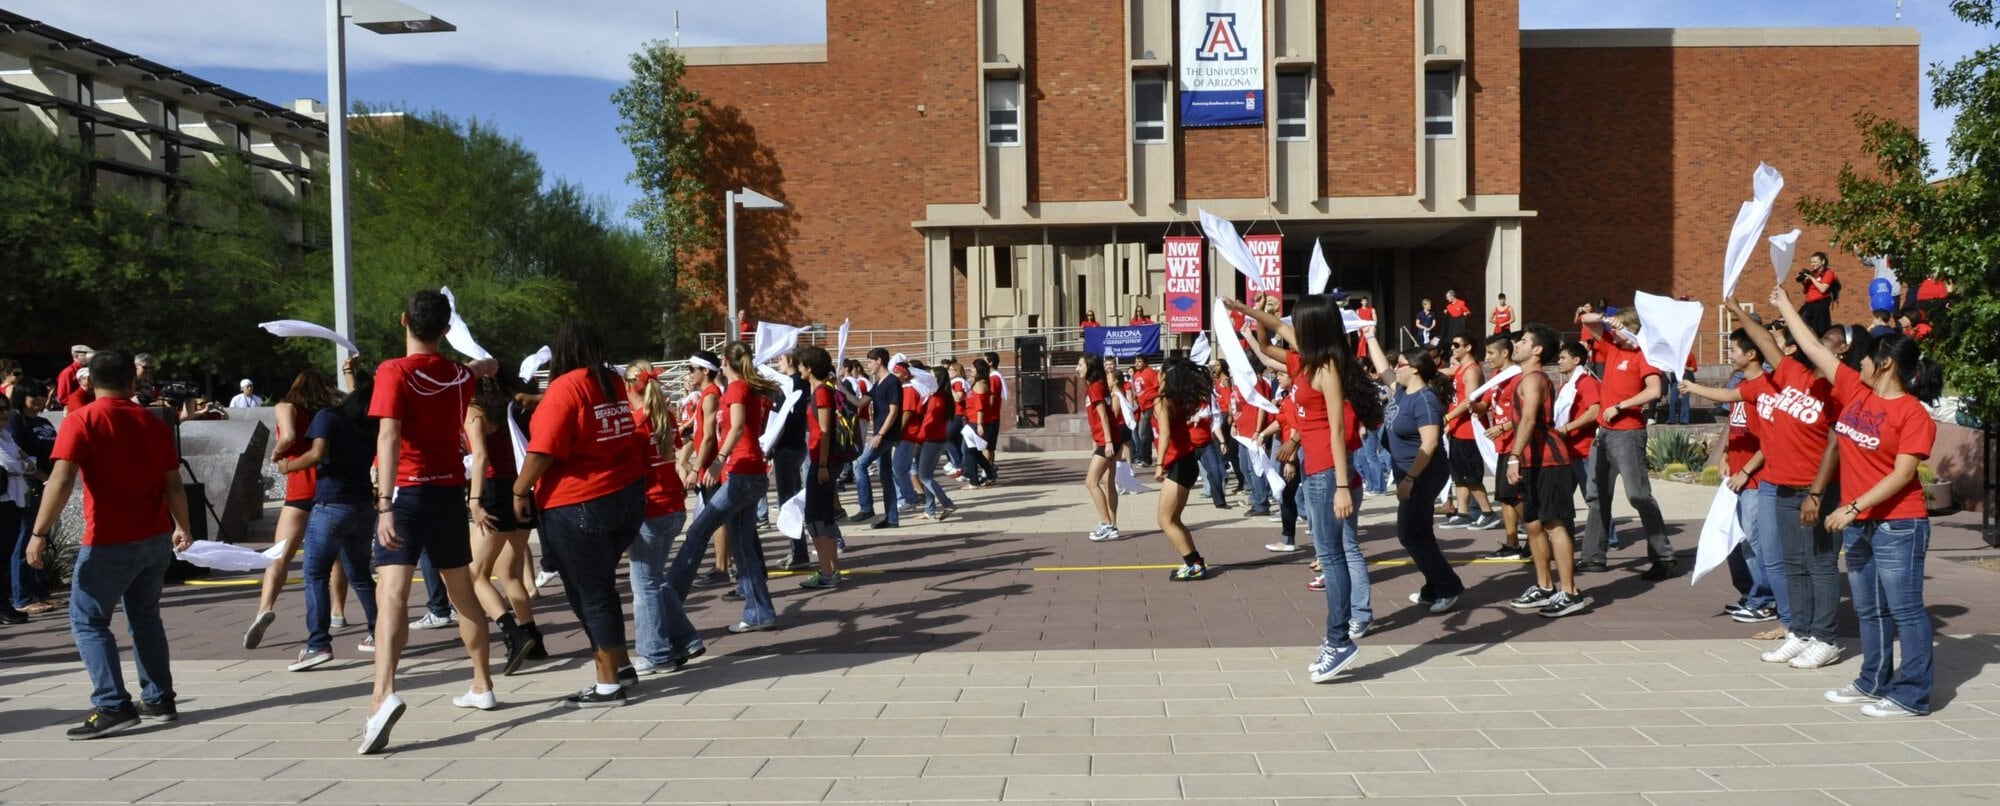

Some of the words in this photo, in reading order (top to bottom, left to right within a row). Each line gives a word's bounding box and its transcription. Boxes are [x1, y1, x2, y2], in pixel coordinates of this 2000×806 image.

[1195, 12, 1248, 61] A
[1186, 67, 1204, 77] THE
[1205, 66, 1259, 77] UNIVERSITY
[1193, 78, 1205, 88] OF
[1206, 78, 1251, 88] ARIZONA
[1167, 241, 1200, 257] NOW
[1247, 240, 1280, 255] NOW
[1166, 256, 1200, 278] WE
[1167, 277, 1200, 294] CAN!
[1171, 314, 1200, 322] ARIZONA
[1106, 330, 1141, 338] ARIZONA
[1780, 385, 1825, 413] ACTION
[1773, 392, 1819, 425] HERO
